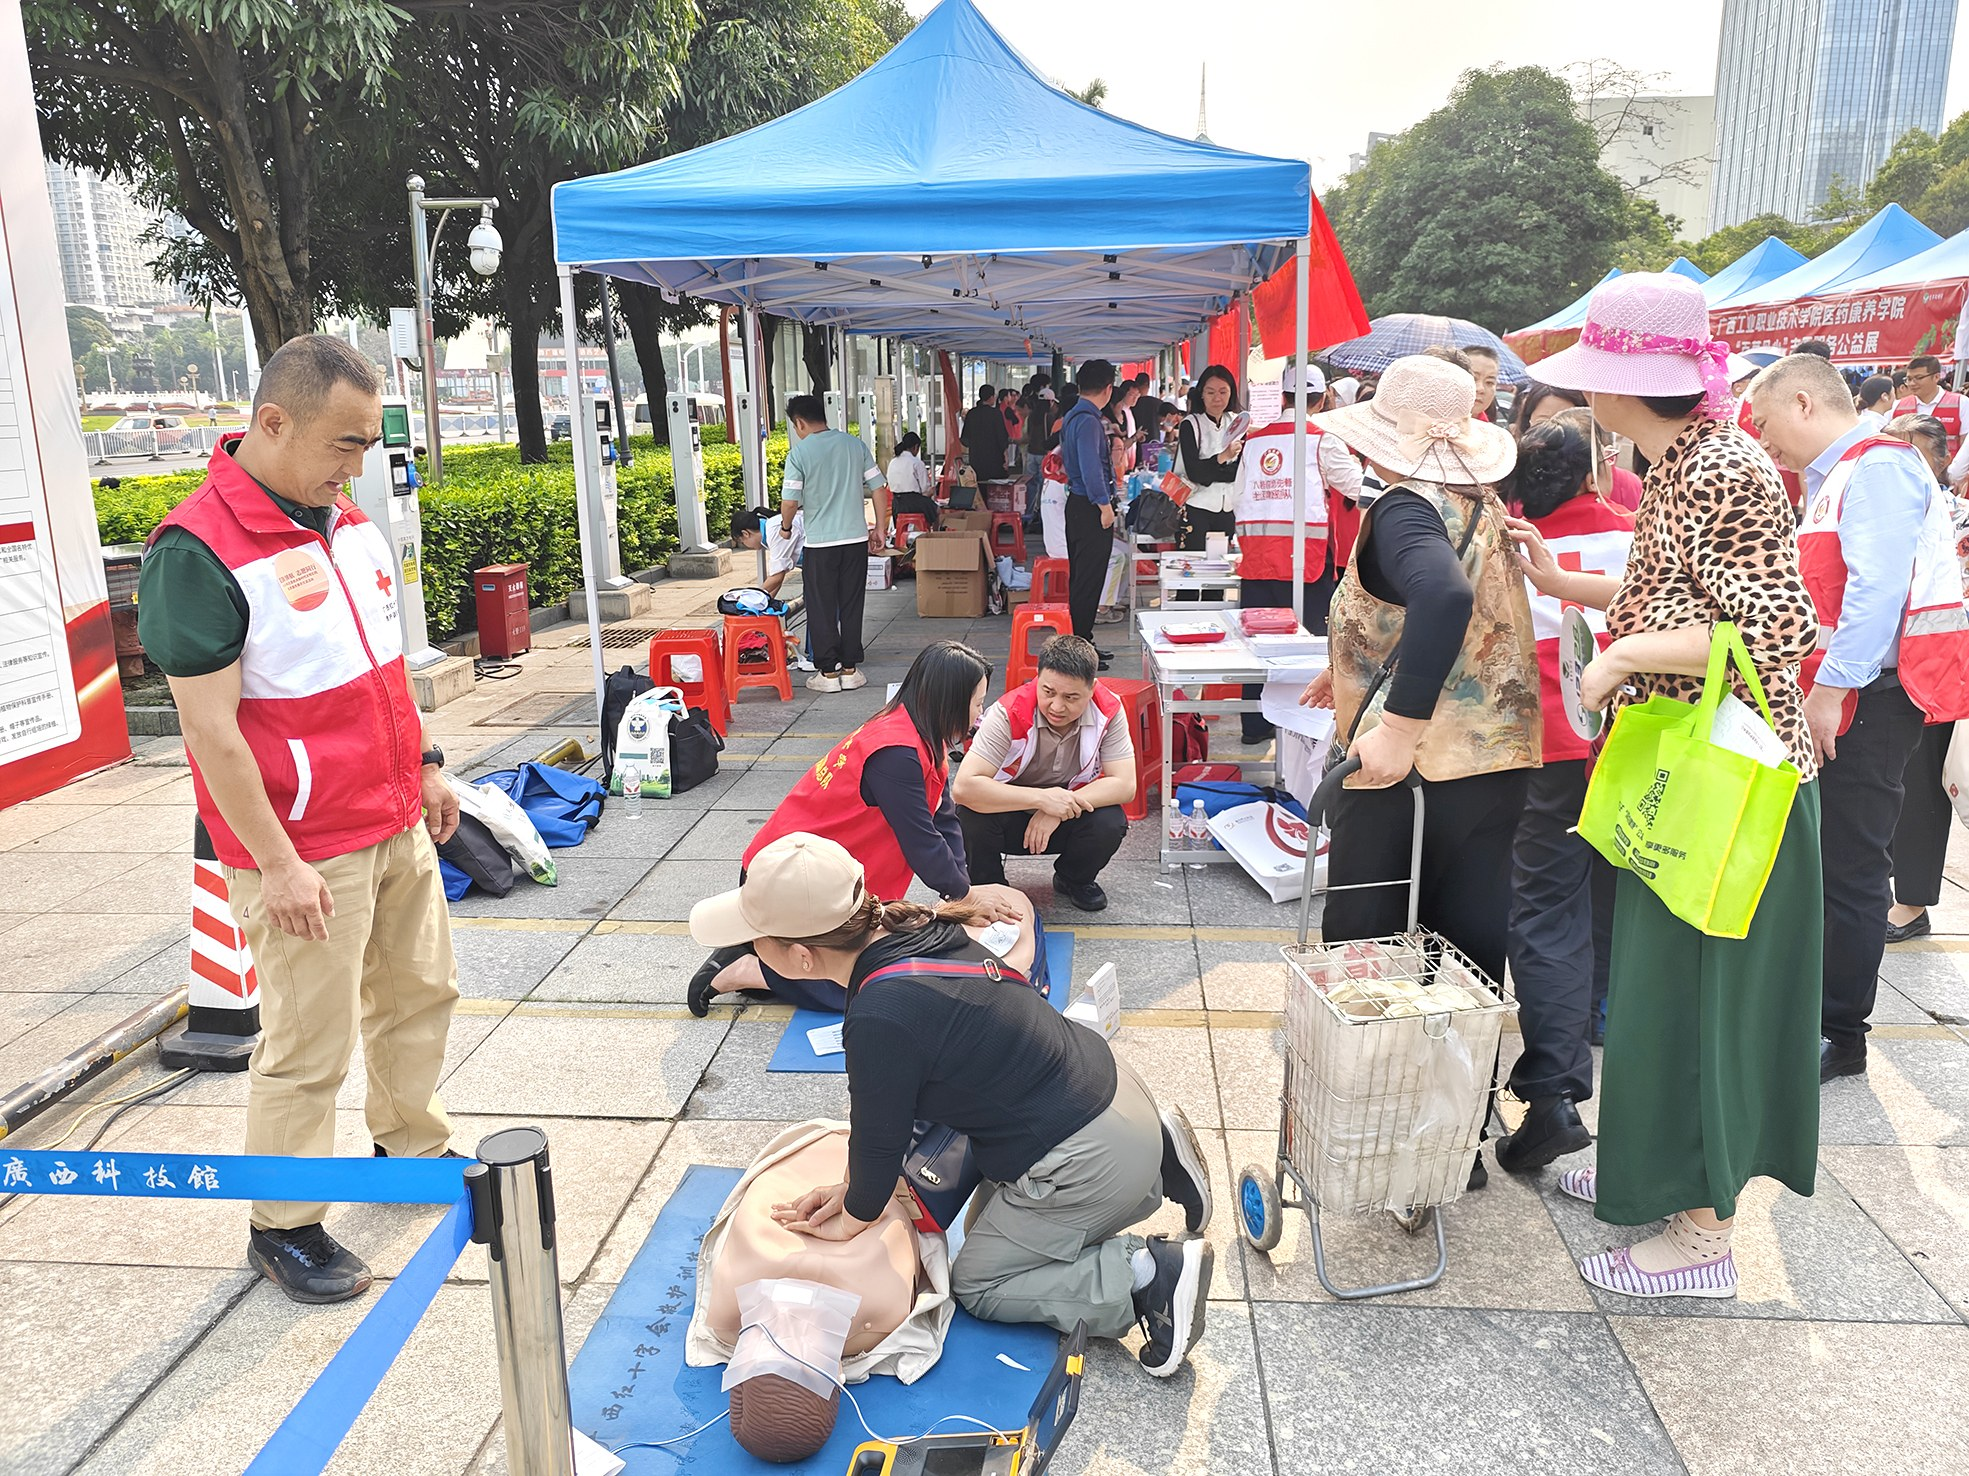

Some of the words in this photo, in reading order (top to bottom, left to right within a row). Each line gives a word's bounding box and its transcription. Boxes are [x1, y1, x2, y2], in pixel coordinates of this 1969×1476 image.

[1716, 296, 1906, 336] 广西工业职业技术学院医药康养学院
